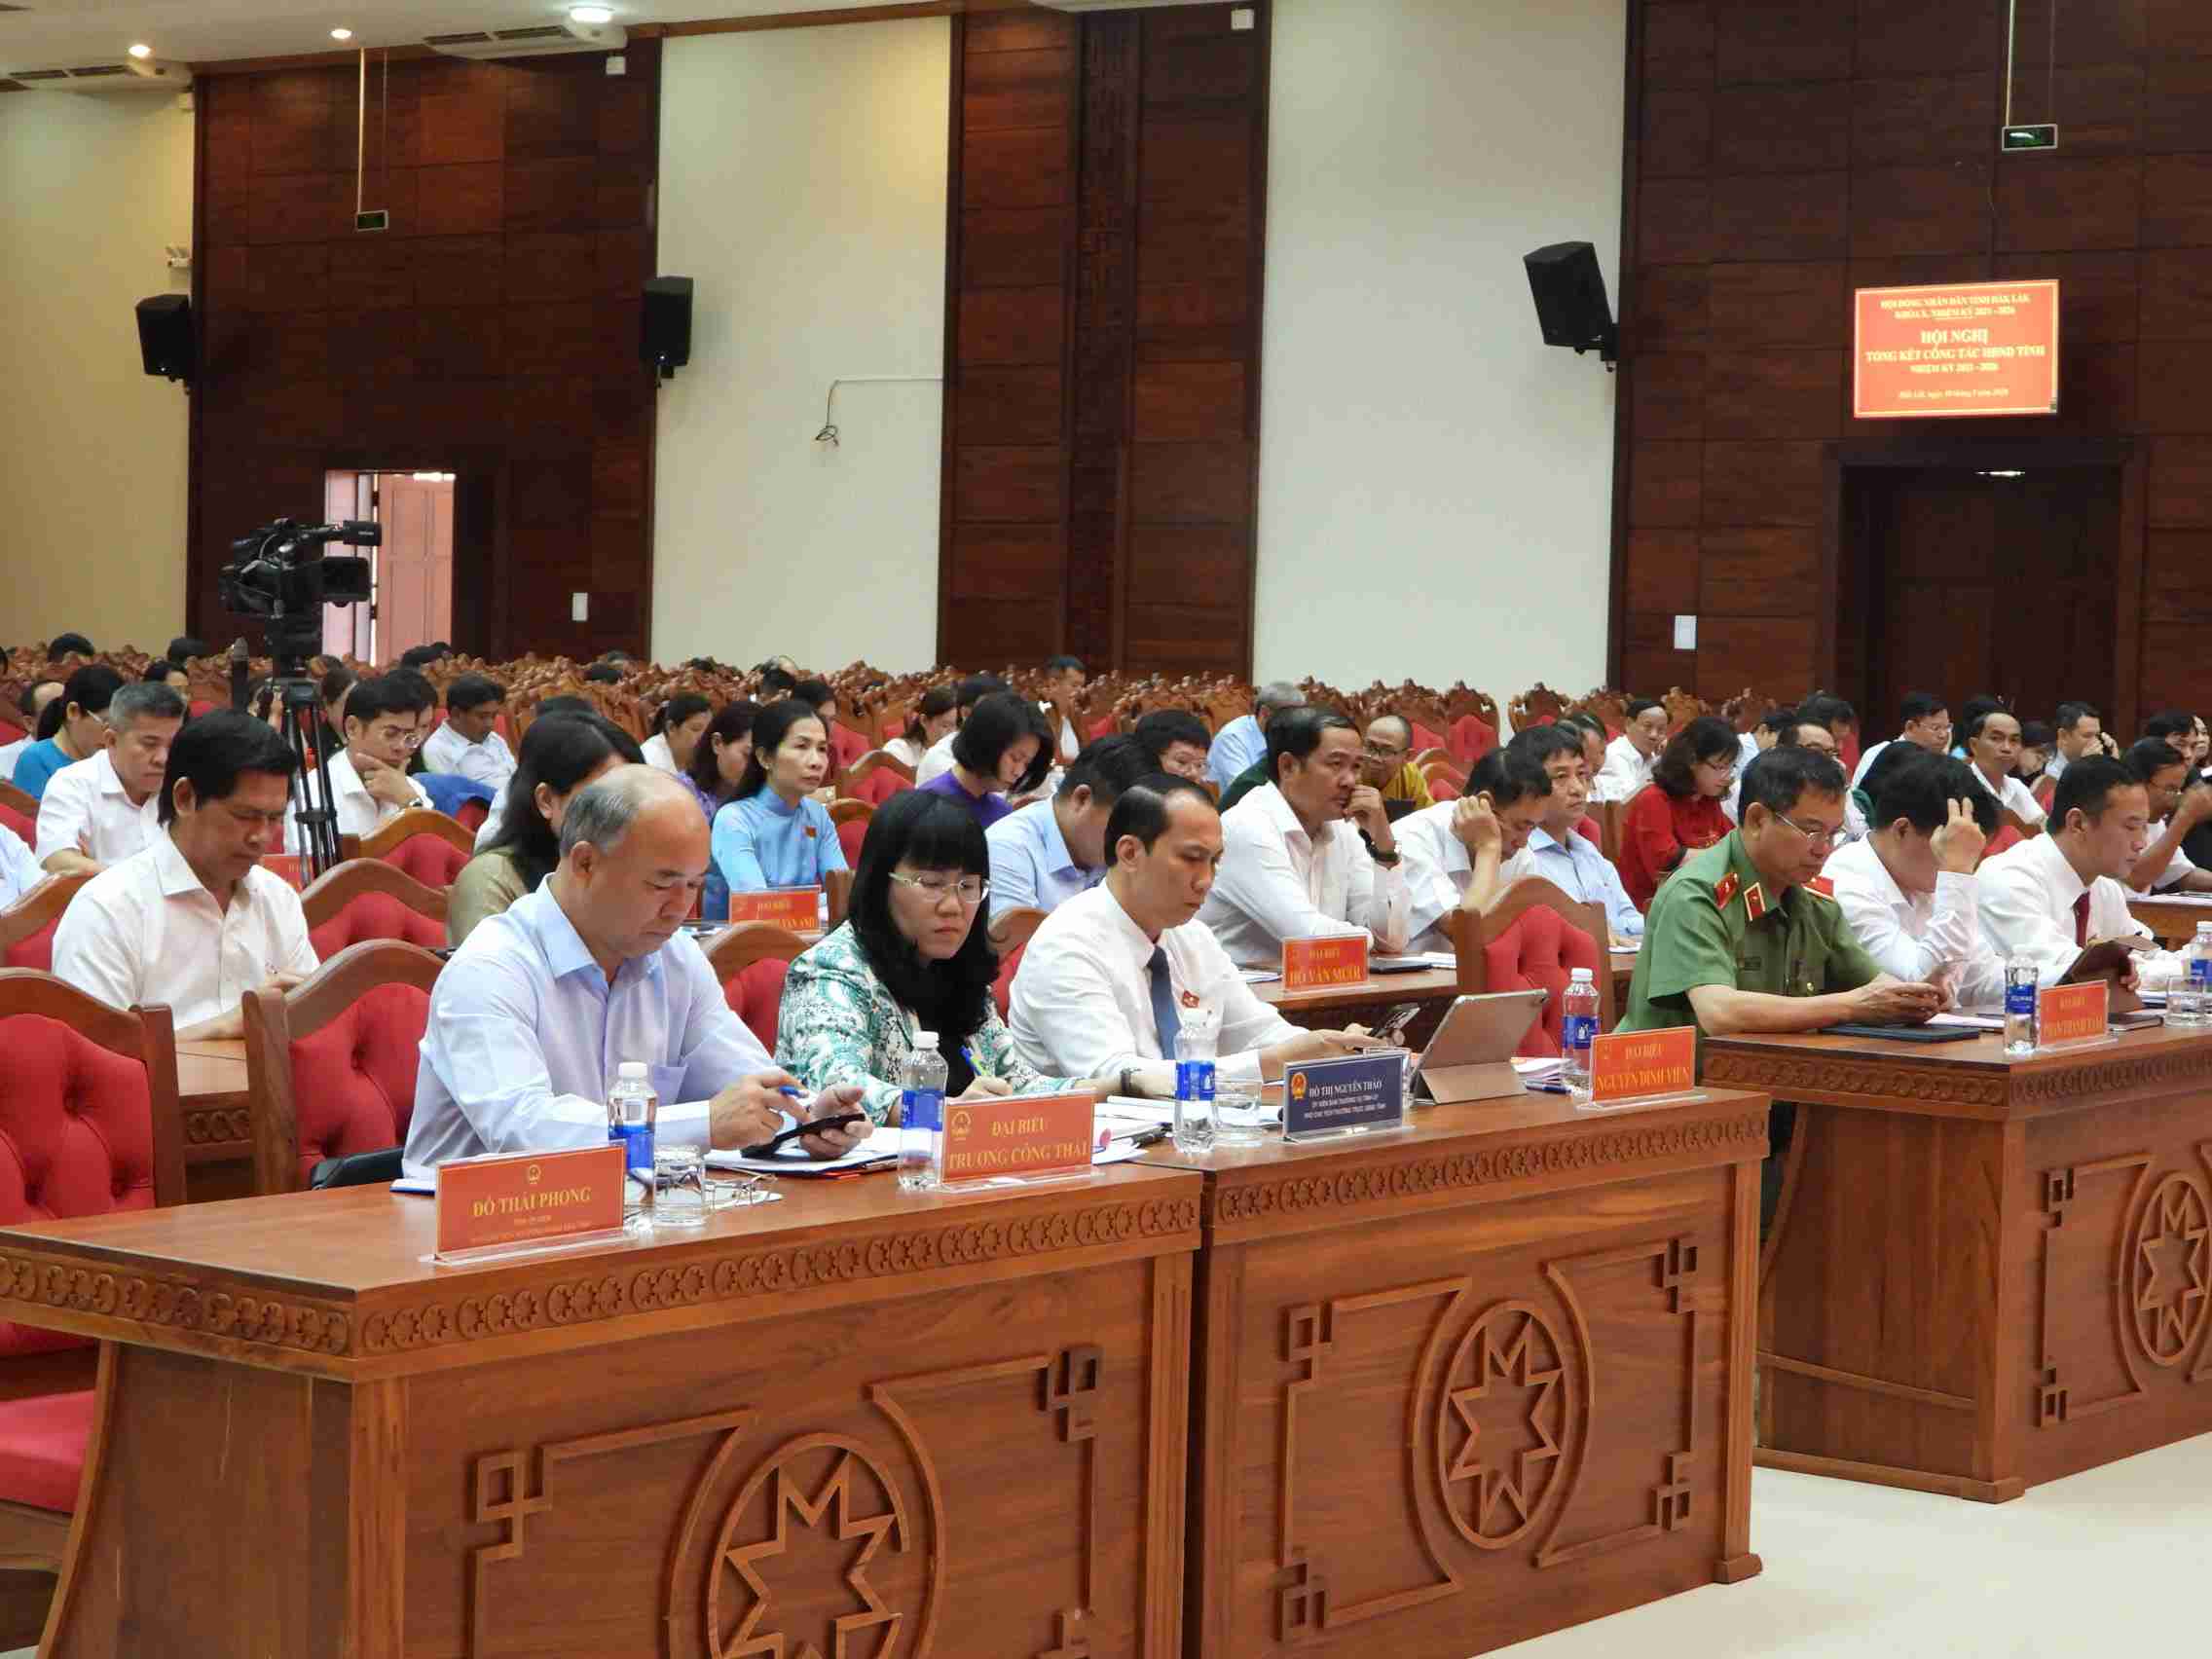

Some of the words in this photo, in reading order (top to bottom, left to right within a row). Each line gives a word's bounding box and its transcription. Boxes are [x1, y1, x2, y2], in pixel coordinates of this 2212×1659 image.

[1921, 328, 1947, 346] HỘI
[1950, 327, 1989, 345] NGHỊ
[498, 1190, 535, 1214] THÁI
[538, 1186, 592, 1208] PHONG
